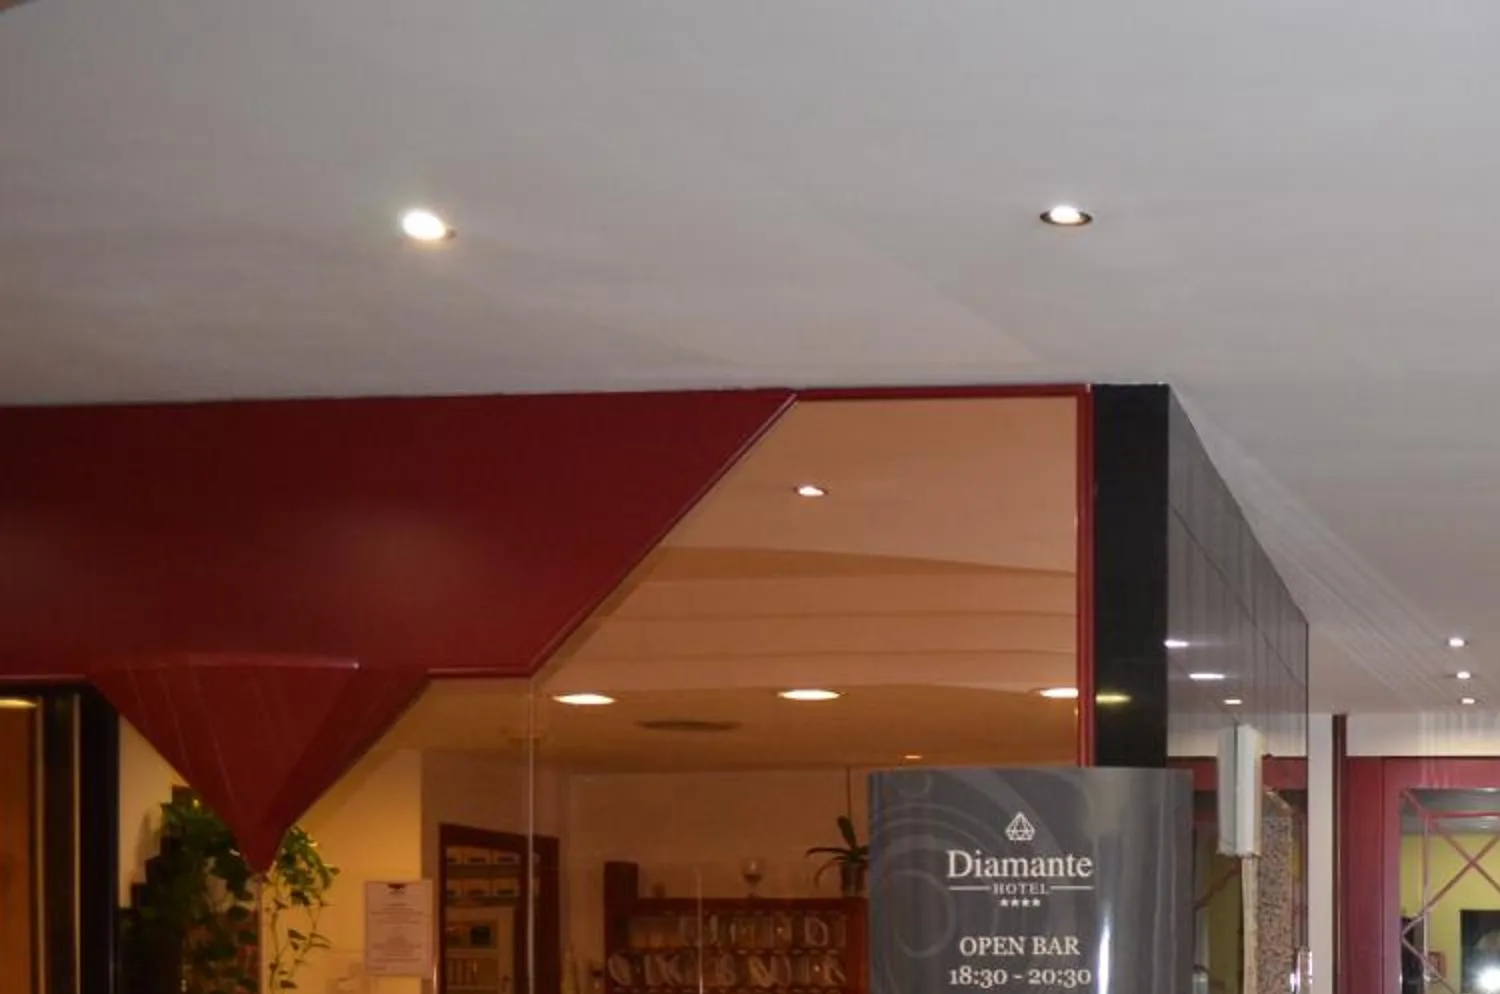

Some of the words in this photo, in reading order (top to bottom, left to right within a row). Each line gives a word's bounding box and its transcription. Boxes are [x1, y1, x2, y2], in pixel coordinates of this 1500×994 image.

[946, 849, 1094, 878] Diamante
[992, 882, 1049, 896] HOTEL
[959, 935, 1025, 956] OPEN
[1032, 935, 1080, 956] BAR
[949, 965, 1008, 989] 18:30
[1027, 968, 1091, 989] 20:30
